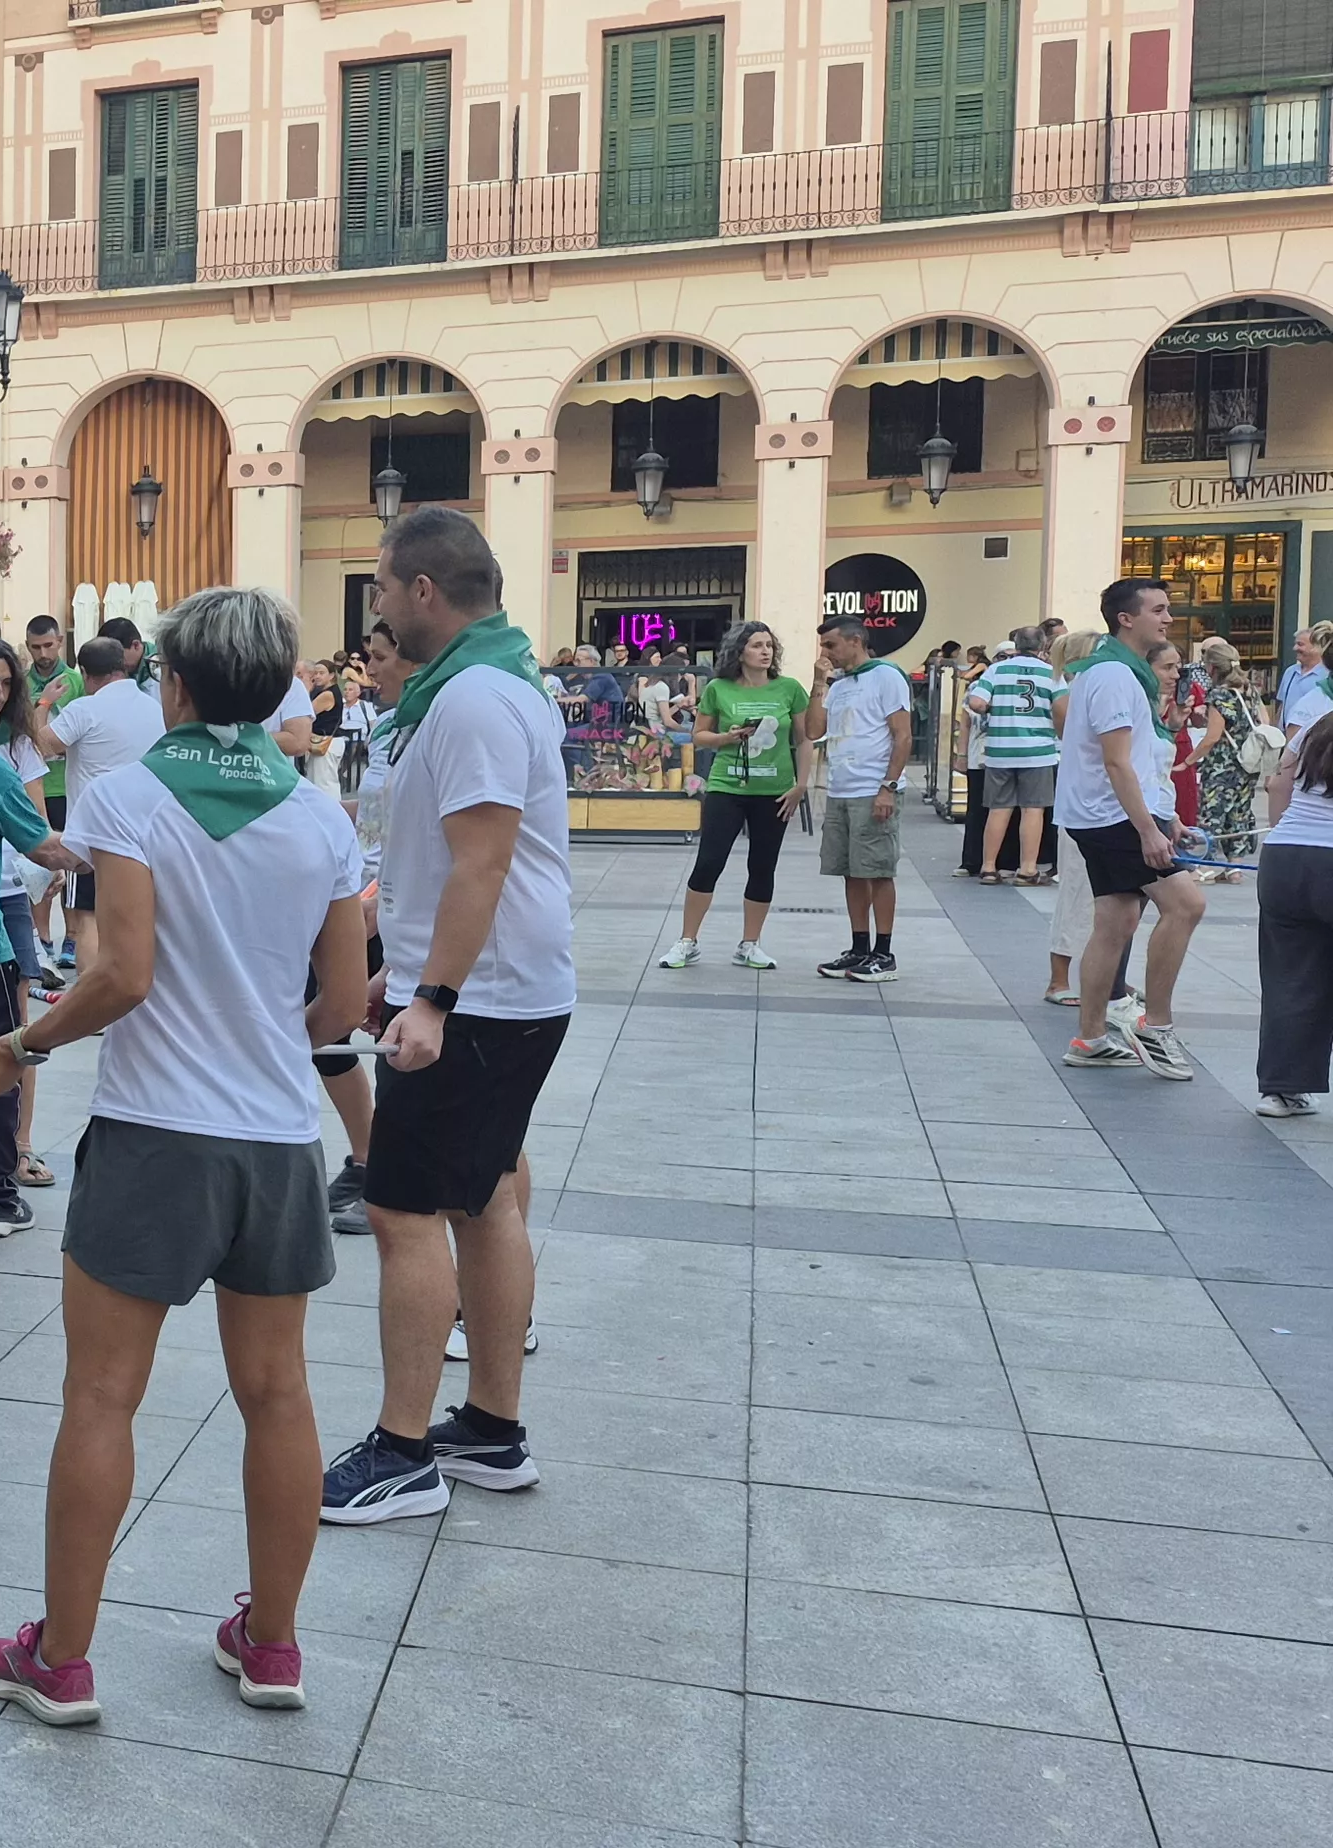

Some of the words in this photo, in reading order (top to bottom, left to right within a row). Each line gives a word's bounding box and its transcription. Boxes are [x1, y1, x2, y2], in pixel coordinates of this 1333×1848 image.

[1206, 330, 1229, 342] sus
[1014, 679, 1036, 713] 3
[164, 745, 202, 762] San
[207, 747, 272, 777] Loreno
